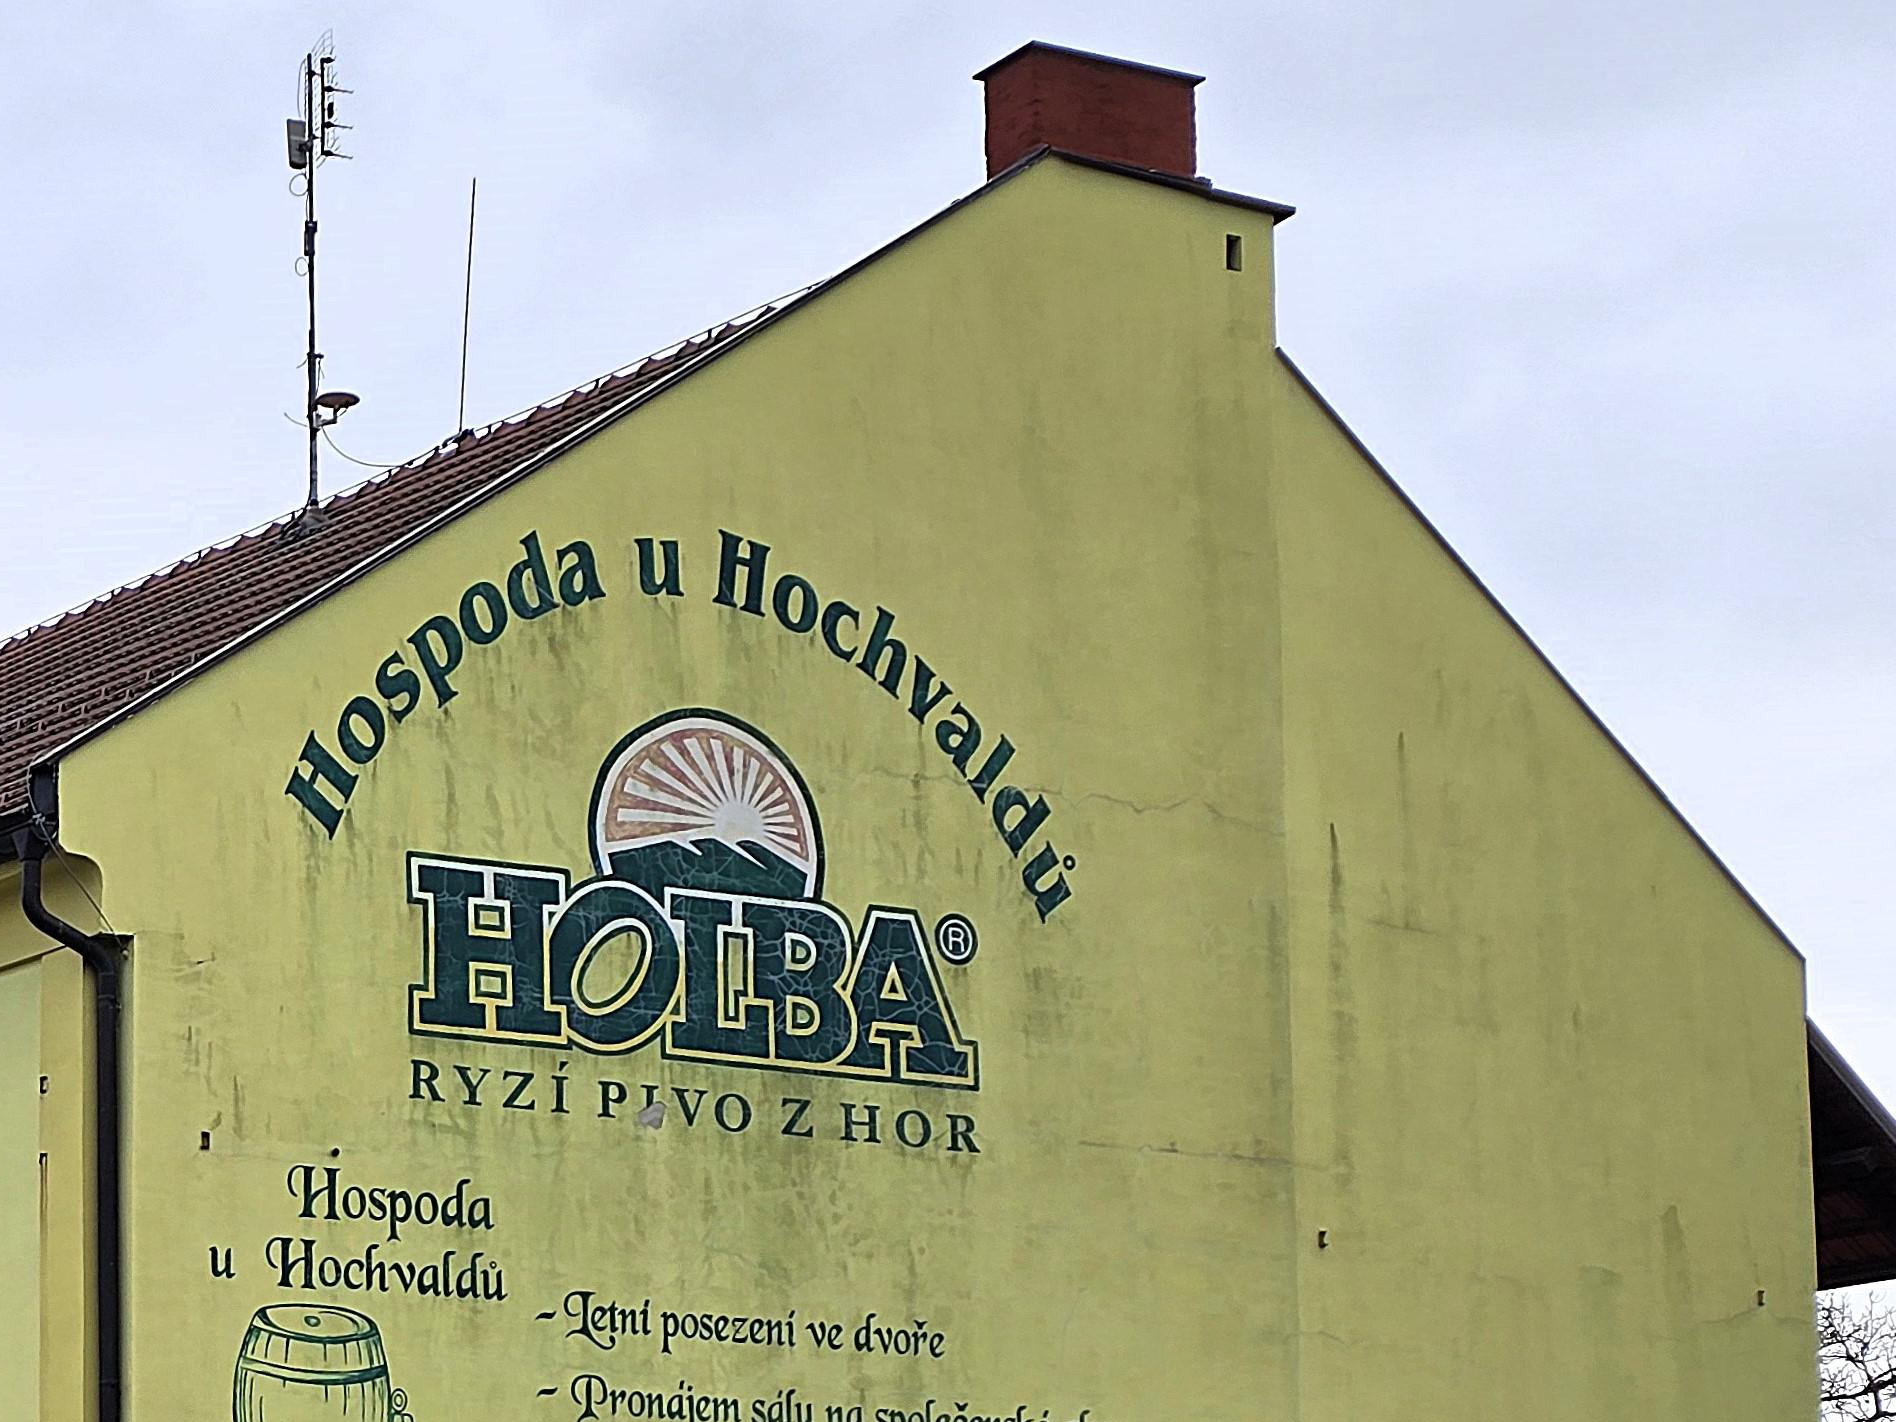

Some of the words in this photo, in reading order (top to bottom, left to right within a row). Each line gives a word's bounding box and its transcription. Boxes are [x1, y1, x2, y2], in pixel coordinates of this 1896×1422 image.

[285, 530, 606, 840] Hospoda
[635, 537, 683, 597] u
[712, 529, 1078, 923] Hochvaldů
[408, 1059, 571, 1114] RYZÍ
[780, 1098, 815, 1138] Z
[840, 1102, 982, 1153] HOR
[287, 1165, 495, 1241] Hospoda
[209, 1246, 235, 1279] u
[265, 1237, 507, 1301] Hochvaldů
[660, 1310, 797, 1355] posezení
[806, 1321, 844, 1351] ve
[854, 1313, 945, 1358] dvoře
